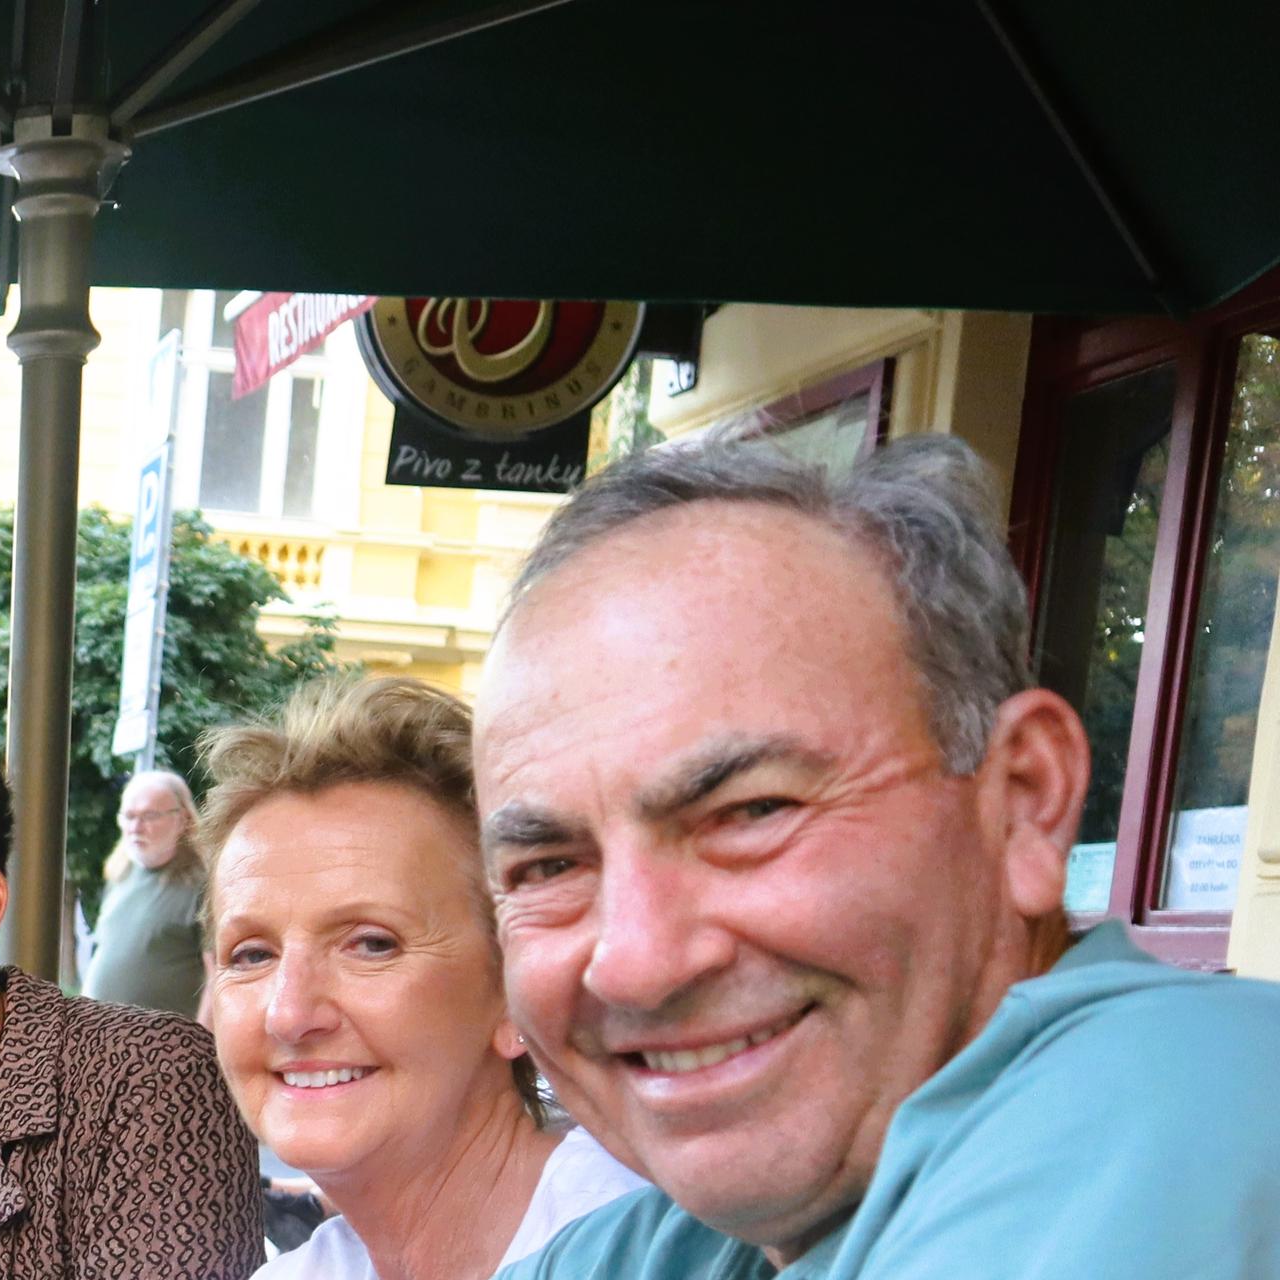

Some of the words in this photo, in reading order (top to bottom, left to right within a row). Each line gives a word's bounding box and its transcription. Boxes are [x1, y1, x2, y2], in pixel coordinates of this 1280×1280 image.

[401, 358, 602, 419] GAMBRINUS
[392, 445, 453, 479] Pivo
[460, 459, 483, 481] z
[495, 450, 584, 487] tanku
